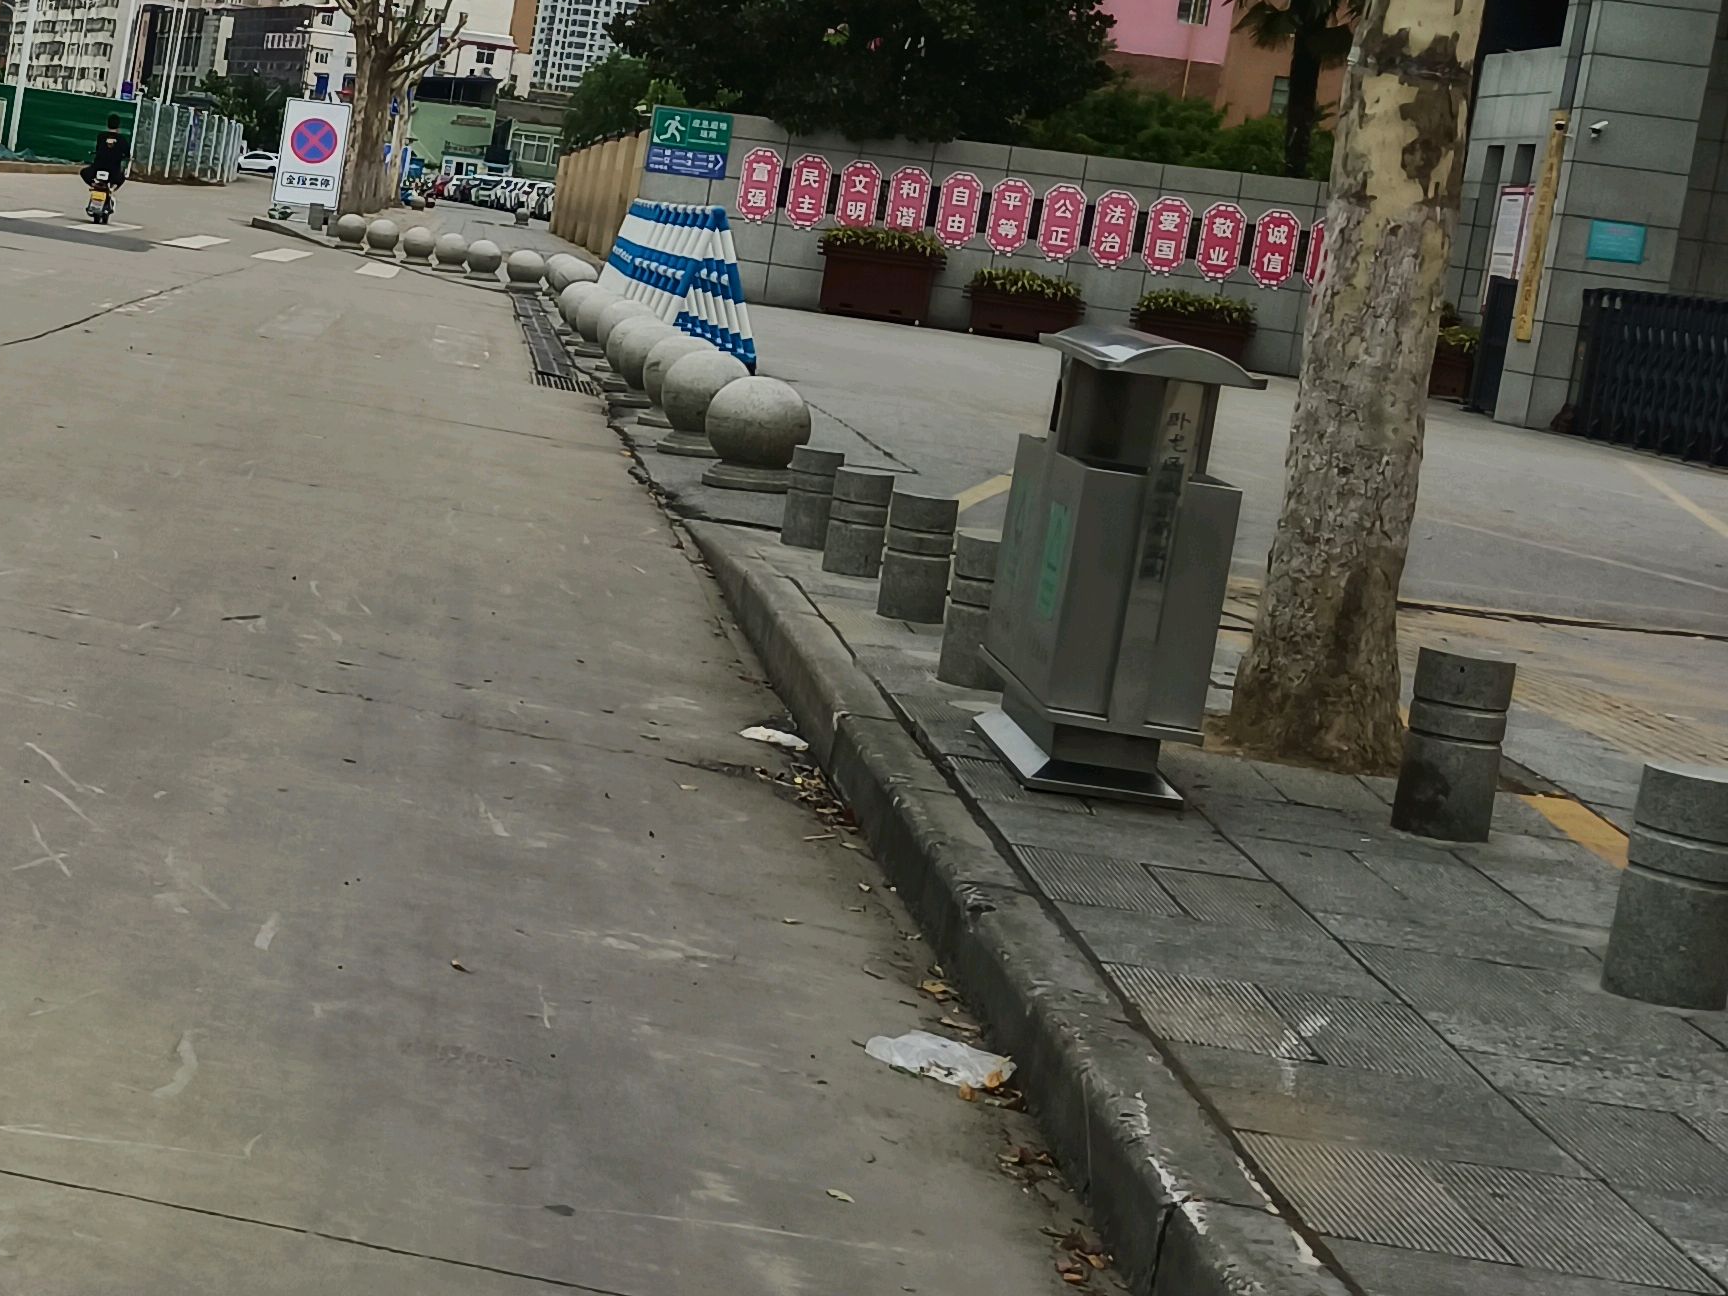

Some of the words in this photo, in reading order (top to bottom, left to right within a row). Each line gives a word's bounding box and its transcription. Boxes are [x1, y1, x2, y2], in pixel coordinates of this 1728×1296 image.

[747, 162, 772, 208] 富强
[795, 167, 820, 215] 民主
[846, 174, 871, 221] 文明
[896, 179, 921, 227] 和谐
[946, 186, 970, 234] 自由
[997, 191, 1023, 238] 平等
[1049, 199, 1075, 247] 公正
[1099, 204, 1127, 253] 法治
[1154, 211, 1181, 260] 爱国
[1206, 217, 1236, 266] 敬业
[1262, 223, 1290, 274] 诚信
